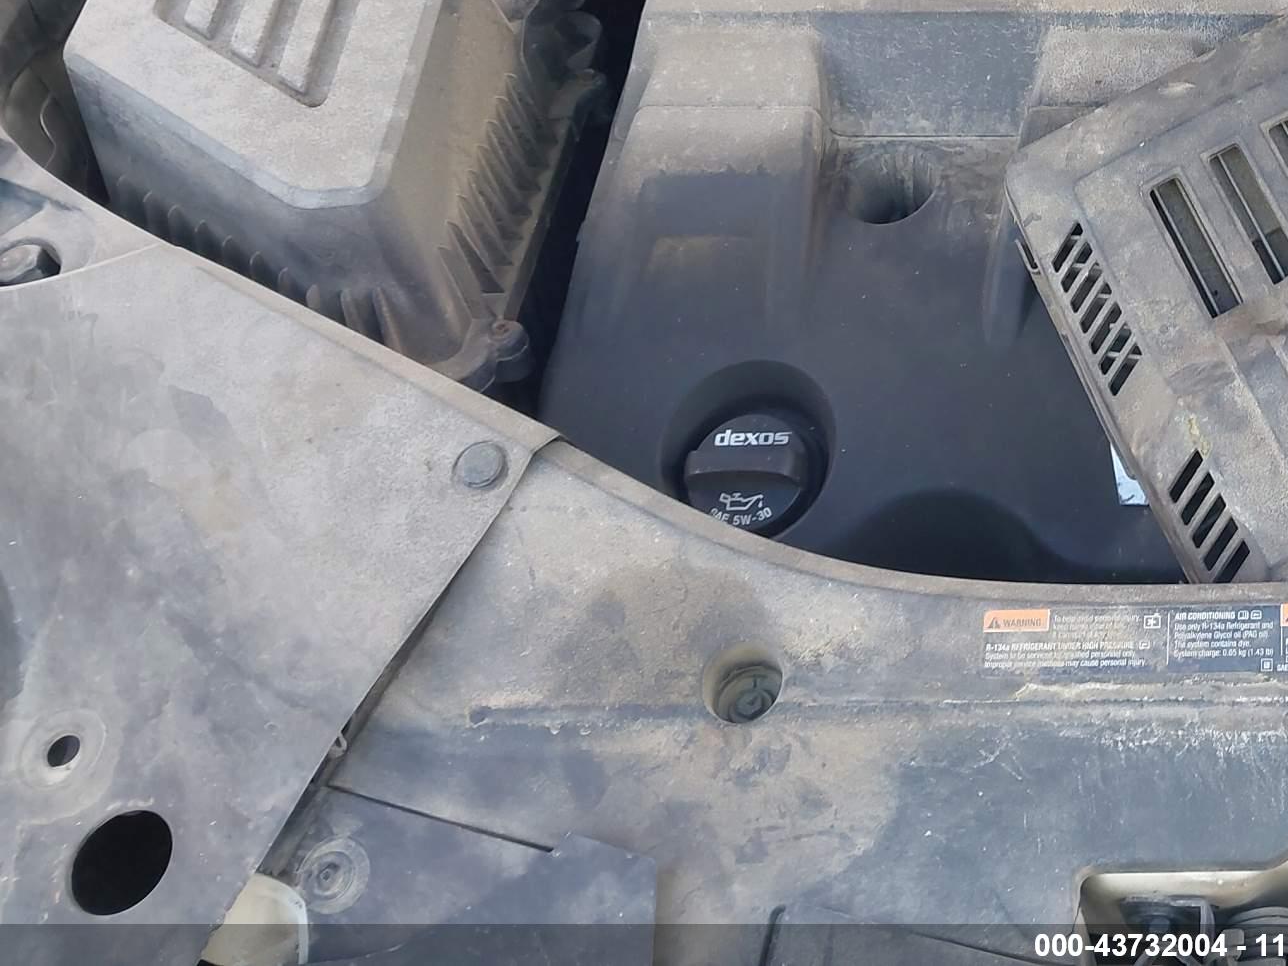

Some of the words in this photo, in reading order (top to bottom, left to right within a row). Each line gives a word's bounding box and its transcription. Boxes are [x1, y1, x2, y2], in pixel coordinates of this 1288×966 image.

[714, 429, 792, 446] dexos
[733, 507, 773, 526] 5W-30
[1175, 612, 1187, 620] AIR
[1188, 611, 1235, 620] CONDITIONING
[1003, 617, 1041, 627] WARNING
[1226, 622, 1260, 631] Refrigerant
[1011, 642, 1056, 651] REFRIGERANT
[1211, 640, 1237, 648] contains
